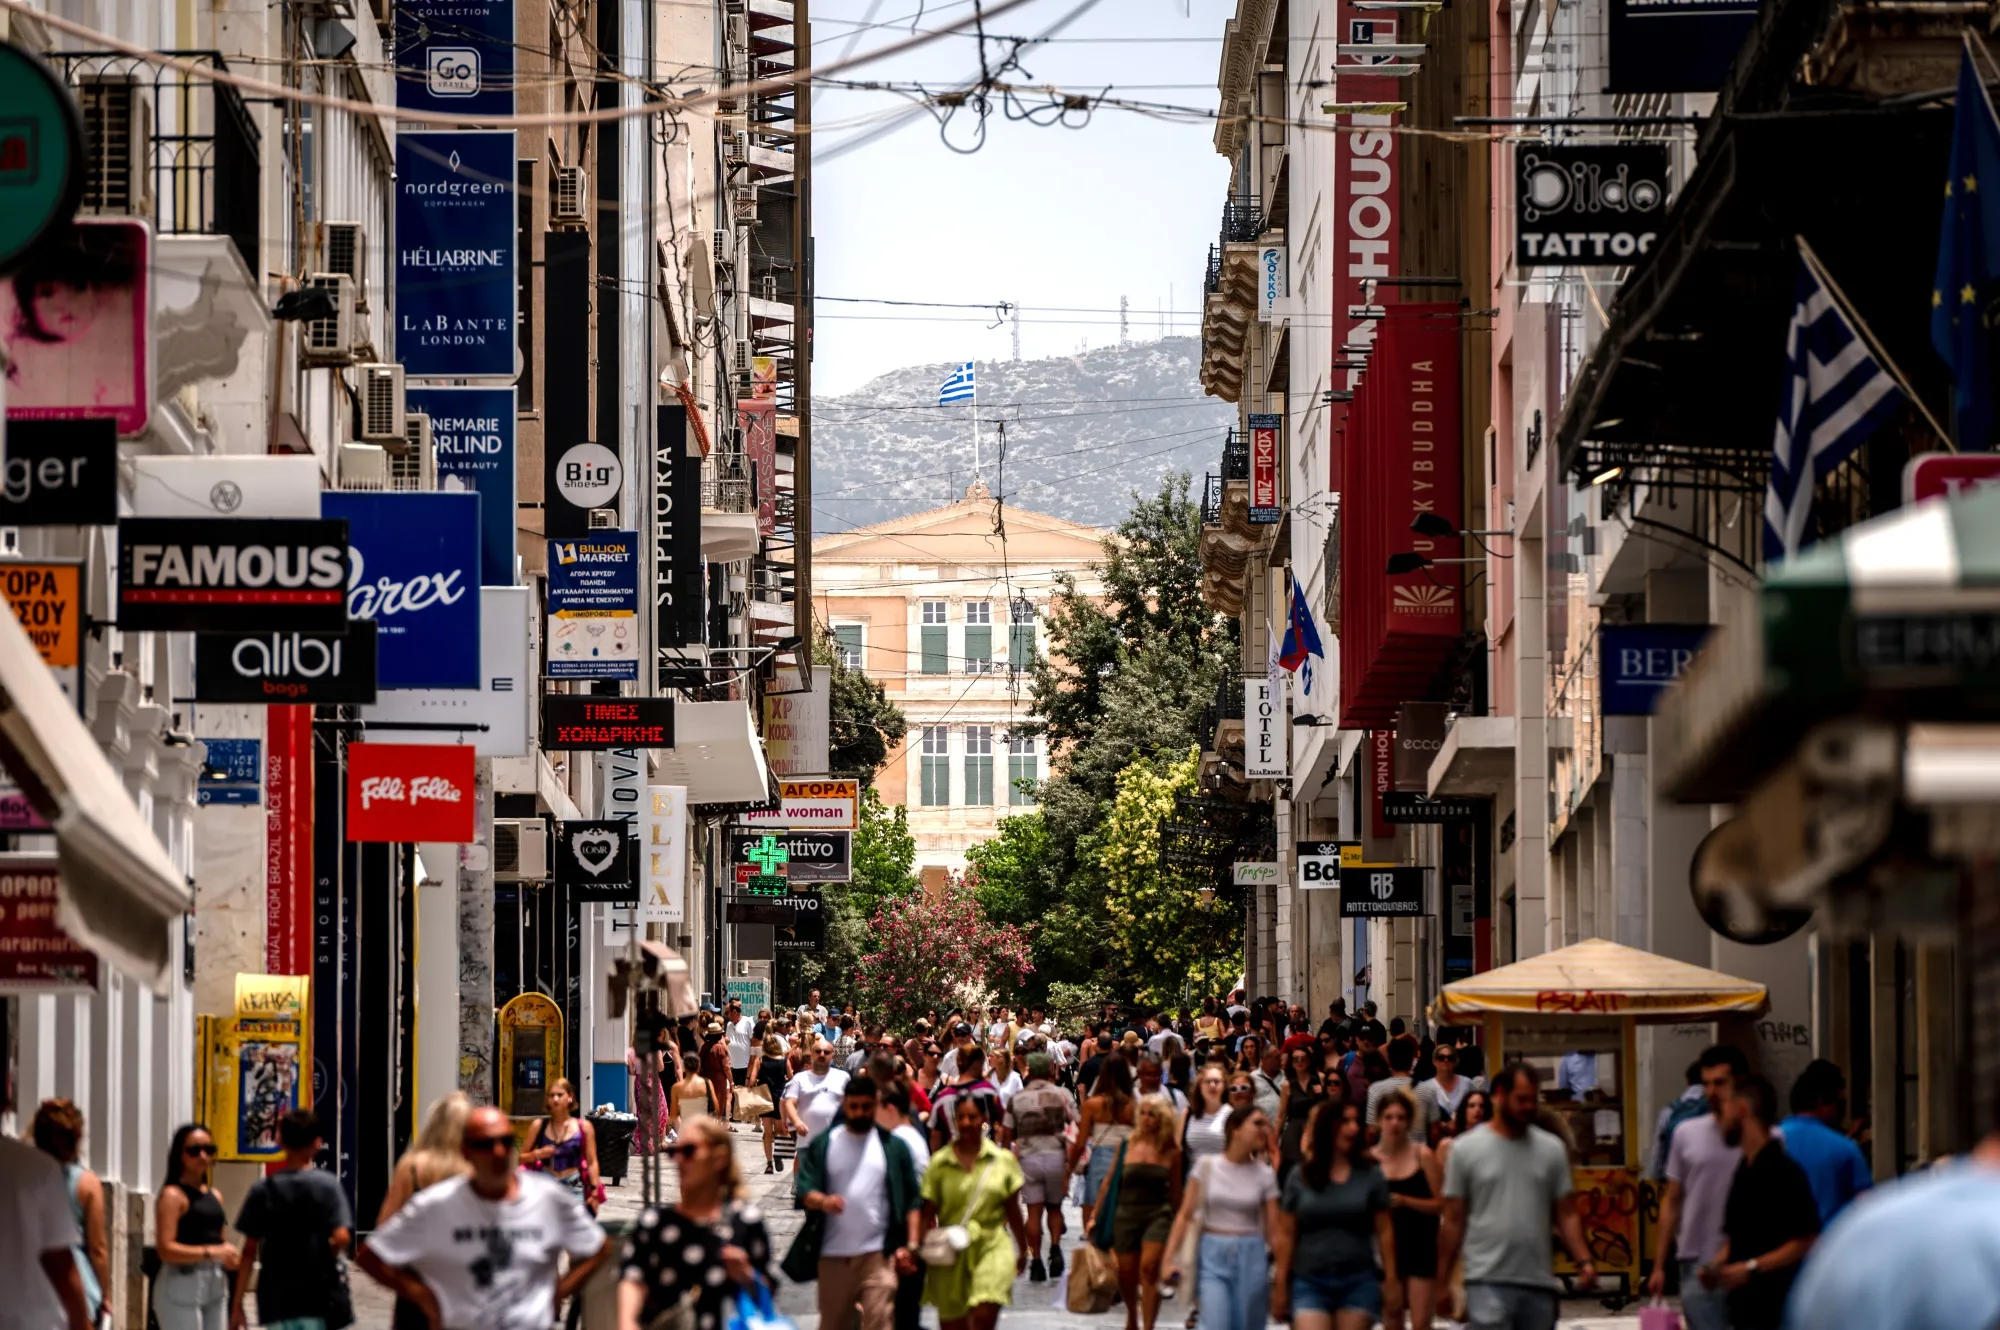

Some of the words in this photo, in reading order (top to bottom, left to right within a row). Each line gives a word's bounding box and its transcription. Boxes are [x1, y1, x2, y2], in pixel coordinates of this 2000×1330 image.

[417, 8, 491, 16] COLLECTION
[405, 180, 505, 197] nordgreen
[402, 246, 504, 267] HÉLIABRINE
[420, 335, 487, 346] LONDON
[430, 418, 500, 432] NEMARIE
[457, 461, 499, 469] BEAUTY
[566, 462, 610, 485] Big
[564, 480, 598, 488] shoes
[656, 446, 673, 606] SEPHORA
[579, 544, 627, 554] BILLION
[132, 544, 344, 588] FAMOUS
[579, 553, 631, 563] MARKET
[9, 599, 66, 626] ΣΟΥ
[231, 631, 342, 678] alibi
[263, 681, 309, 697] bags
[1258, 685, 1273, 763] HOTEL
[557, 726, 664, 742] ΧΟΝΔΡΙΚΗΣ
[1402, 738, 1442, 750] ecco
[268, 754, 282, 787] 1962
[360, 776, 405, 811] Folli
[410, 776, 462, 806] Follie
[784, 783, 848, 797] ΑΓΟΡΑ
[785, 807, 844, 819] woman
[1384, 805, 1472, 816] FUNKYBUDDHA
[268, 835, 282, 885] BRAZIL
[268, 888, 282, 928] FROM
[318, 876, 330, 964] SHOES
